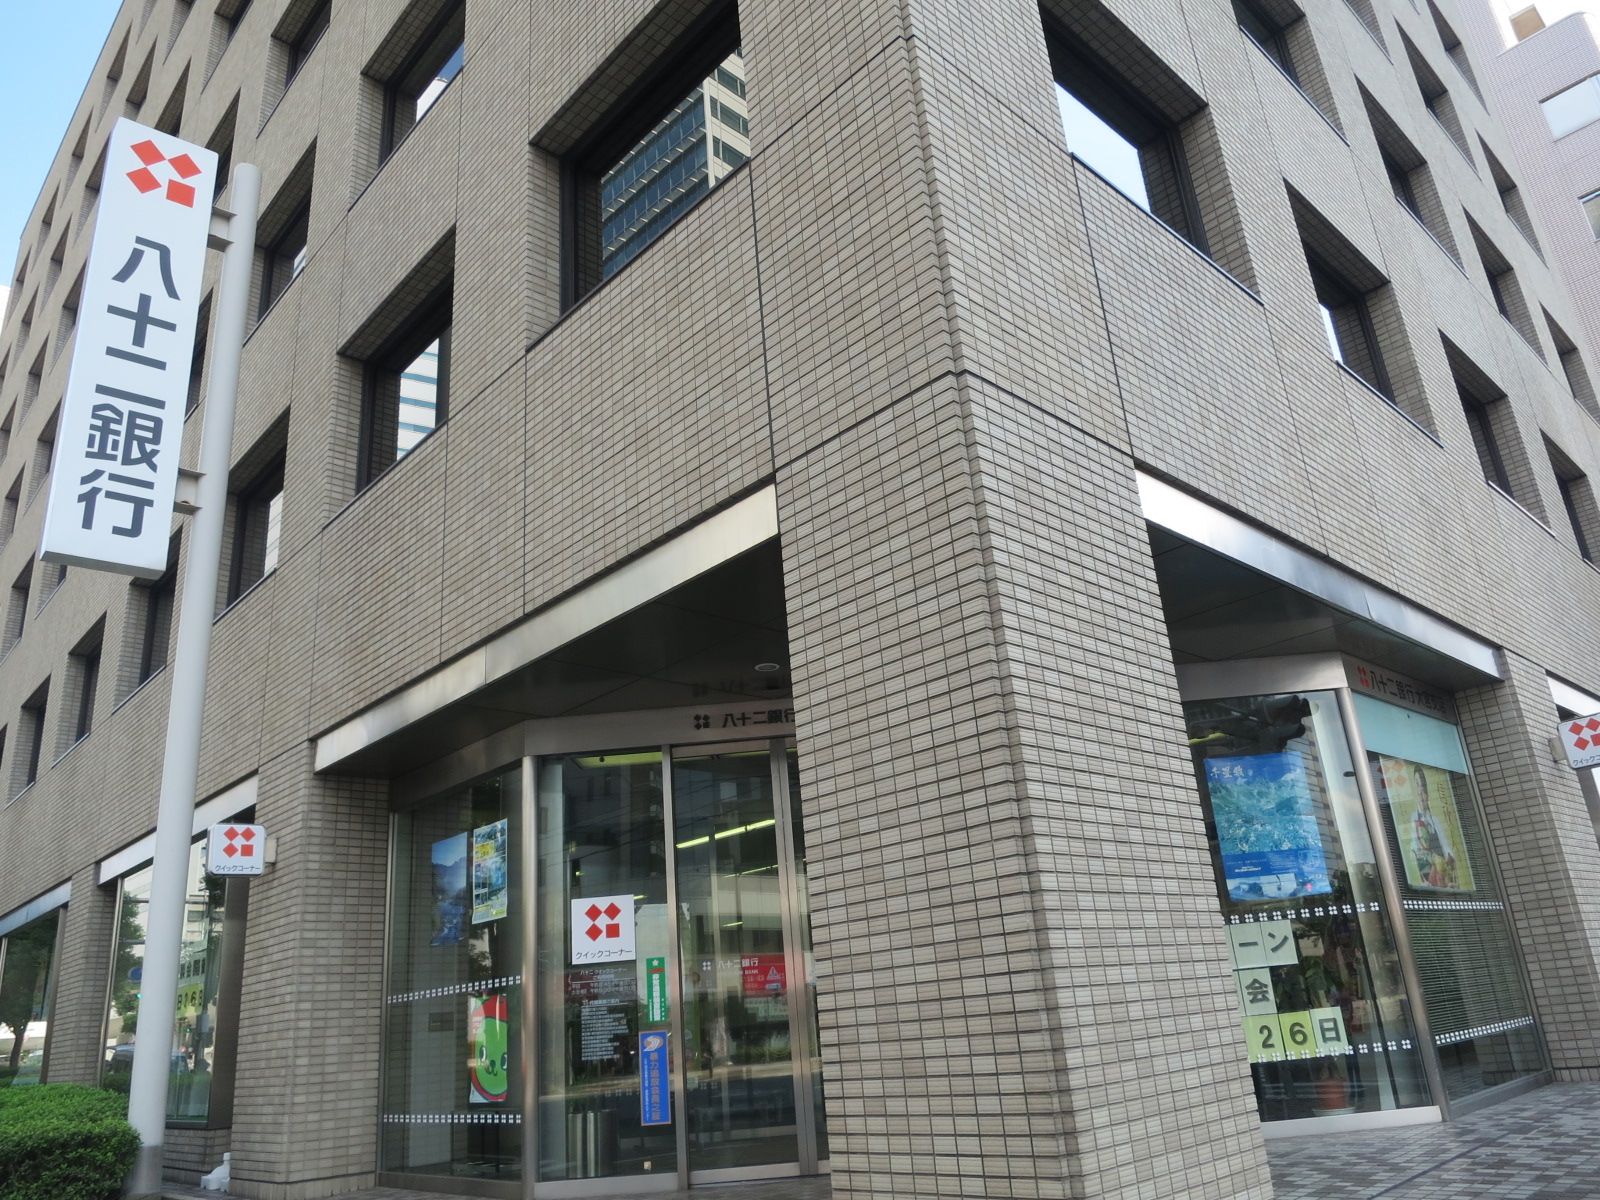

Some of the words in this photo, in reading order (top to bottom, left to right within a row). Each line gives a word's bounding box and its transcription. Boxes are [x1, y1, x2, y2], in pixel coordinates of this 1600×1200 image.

[77, 235, 180, 538] 八十二銀行
[722, 708, 796, 728] 八十二銀行
[214, 864, 261, 873] クイックコーナー
[1238, 931, 1289, 953] ーン
[576, 949, 633, 960] クイックコーナー
[718, 957, 759, 969] 八十二銀行
[1245, 978, 1270, 1004] 会
[1259, 1017, 1341, 1049] 26日
